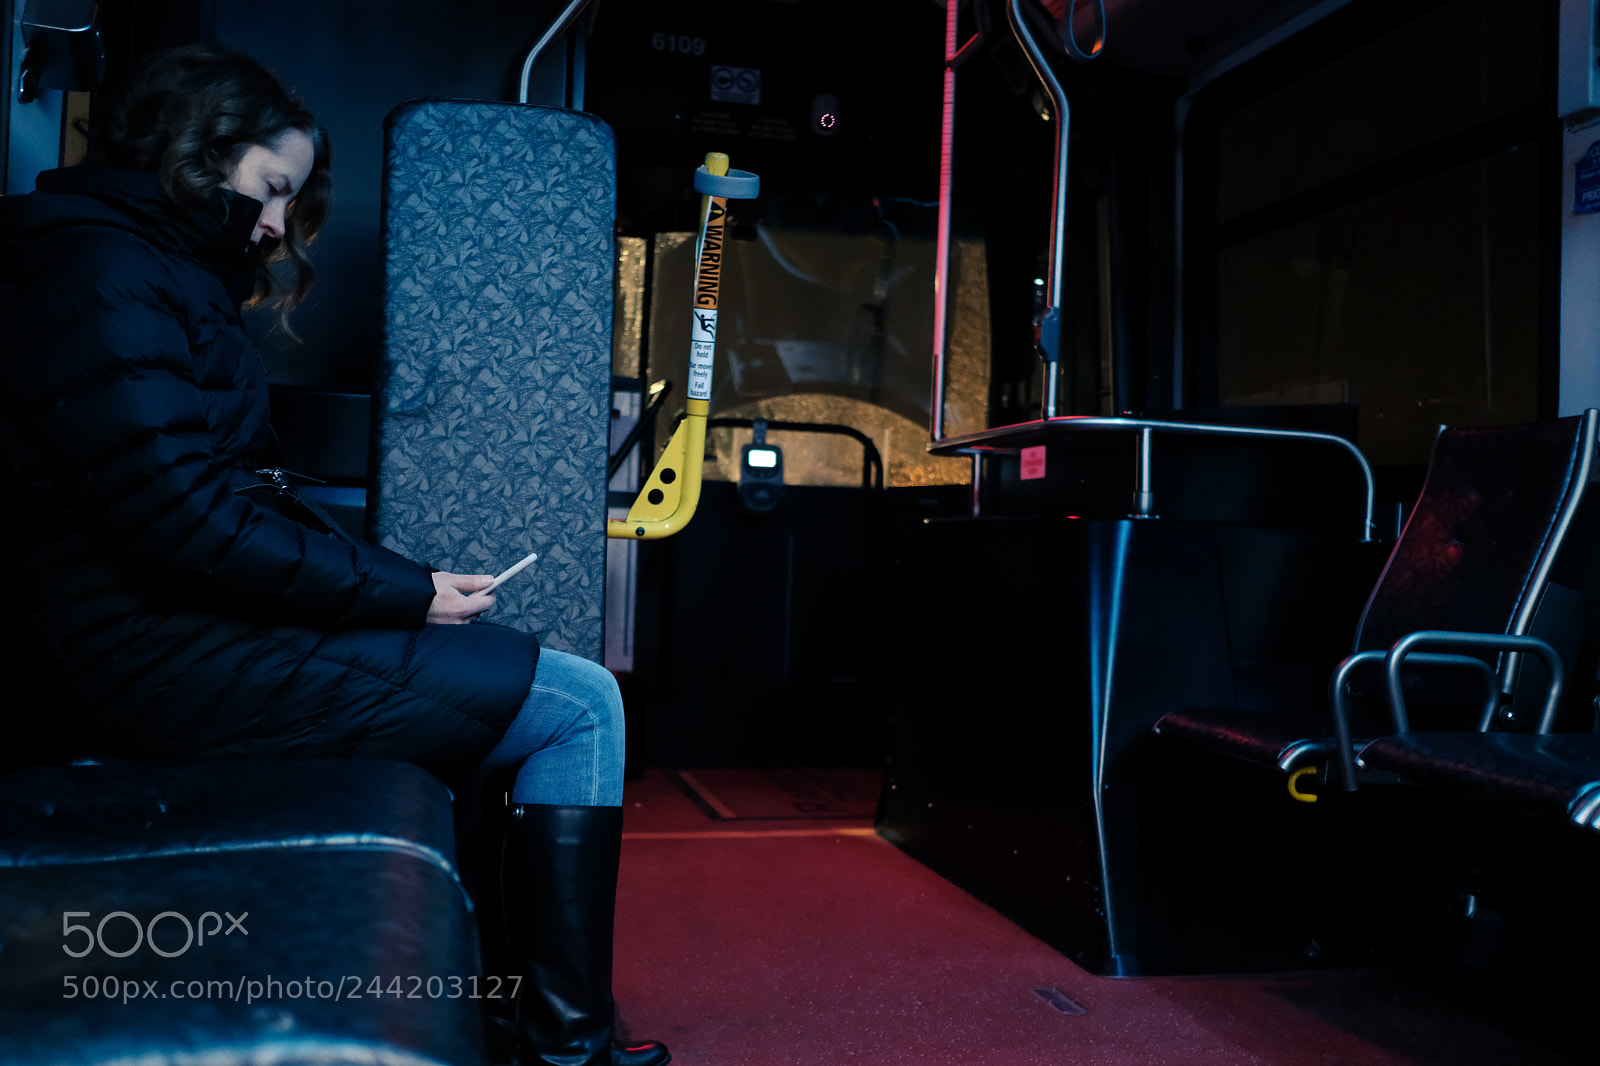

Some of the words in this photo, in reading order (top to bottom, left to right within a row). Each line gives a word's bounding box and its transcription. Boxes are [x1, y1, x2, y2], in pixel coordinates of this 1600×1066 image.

[651, 31, 706, 56] 6109
[697, 225, 723, 305] WARNING
[696, 350, 708, 358] hold
[693, 370, 708, 378] freely
[690, 389, 707, 397] hazard
